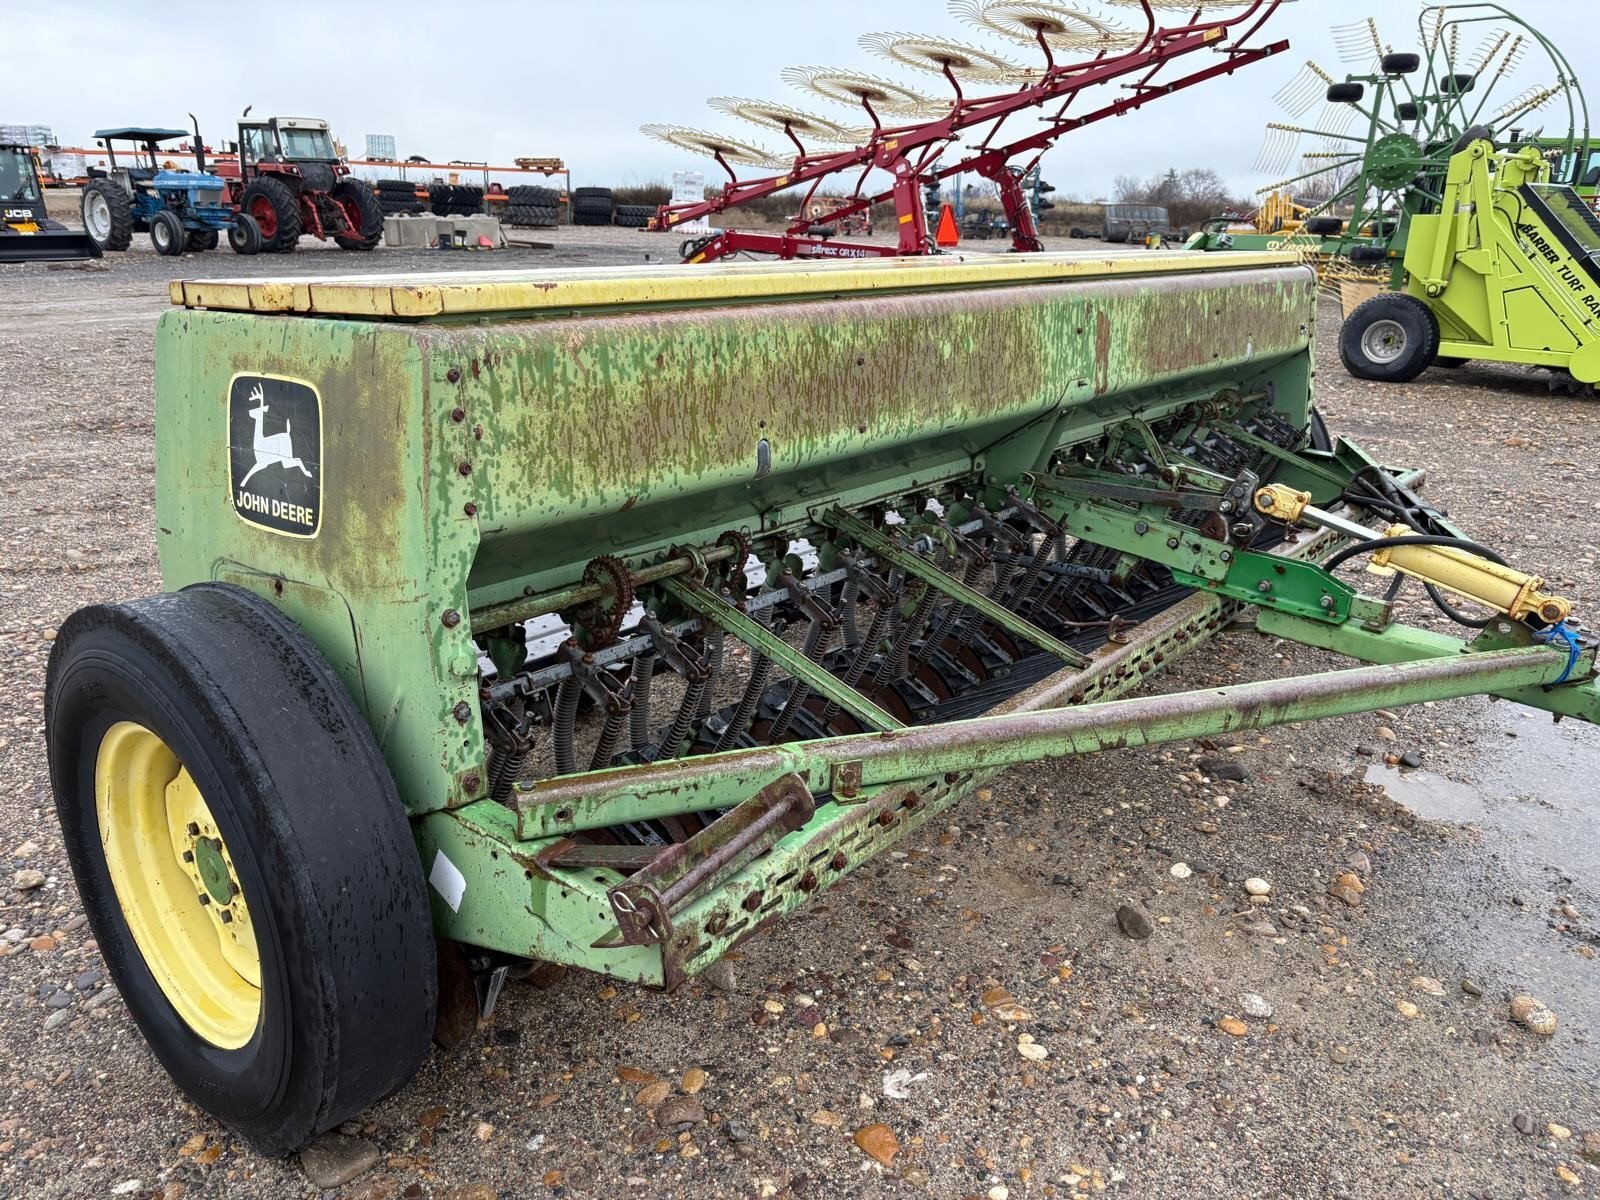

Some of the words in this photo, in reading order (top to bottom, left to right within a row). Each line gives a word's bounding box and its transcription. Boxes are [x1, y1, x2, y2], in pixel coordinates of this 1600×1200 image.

[4, 209, 33, 218] JCB
[1520, 223, 1560, 264] BARBER
[1557, 264, 1586, 292] TURF
[236, 490, 269, 515] JOHN
[271, 500, 314, 526] DEERE
